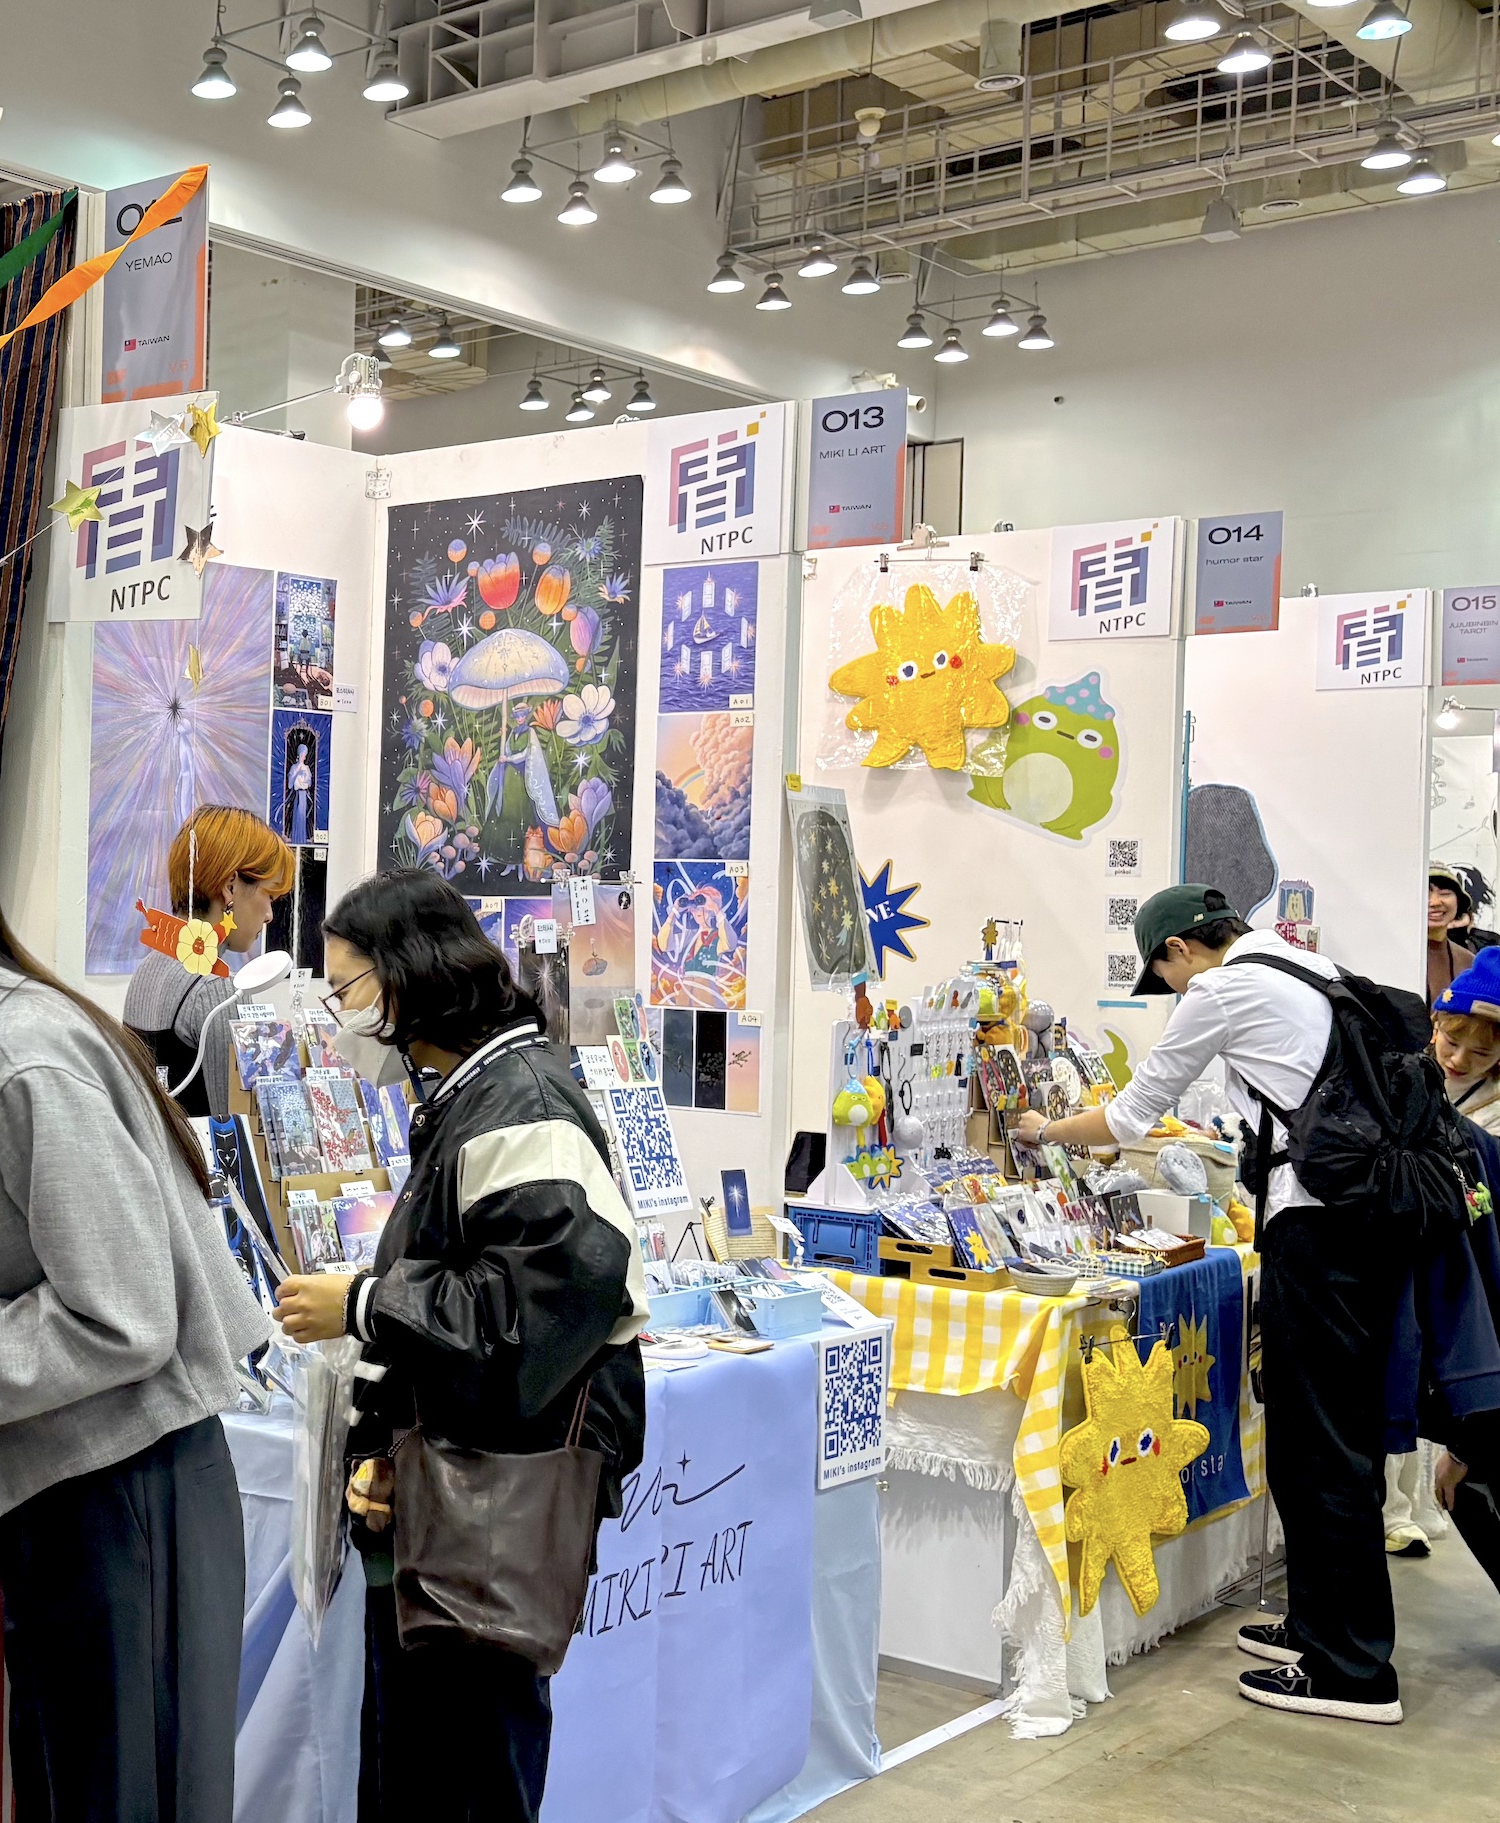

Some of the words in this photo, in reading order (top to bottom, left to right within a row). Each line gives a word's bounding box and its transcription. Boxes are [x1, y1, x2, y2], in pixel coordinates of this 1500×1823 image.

[125, 252, 172, 272] YEMAO
[137, 335, 170, 346] TAIWAN
[822, 406, 884, 433] 013
[819, 448, 844, 459] MIKI
[848, 447, 858, 457] LI
[861, 445, 886, 455] ART
[701, 526, 753, 554] NTPC
[1208, 524, 1264, 545] 014
[1205, 556, 1240, 566] humor
[1243, 555, 1264, 563] star
[110, 575, 171, 612] NTPC
[1451, 595, 1496, 611] 015
[1100, 612, 1146, 634] NTPC
[1361, 667, 1402, 684] NTPC
[637, 1198, 658, 1209] MIKI's
[658, 1195, 689, 1207] instagram
[823, 1464, 846, 1480] MIKI's
[847, 1457, 881, 1473] instagram
[700, 1520, 753, 1591] ART
